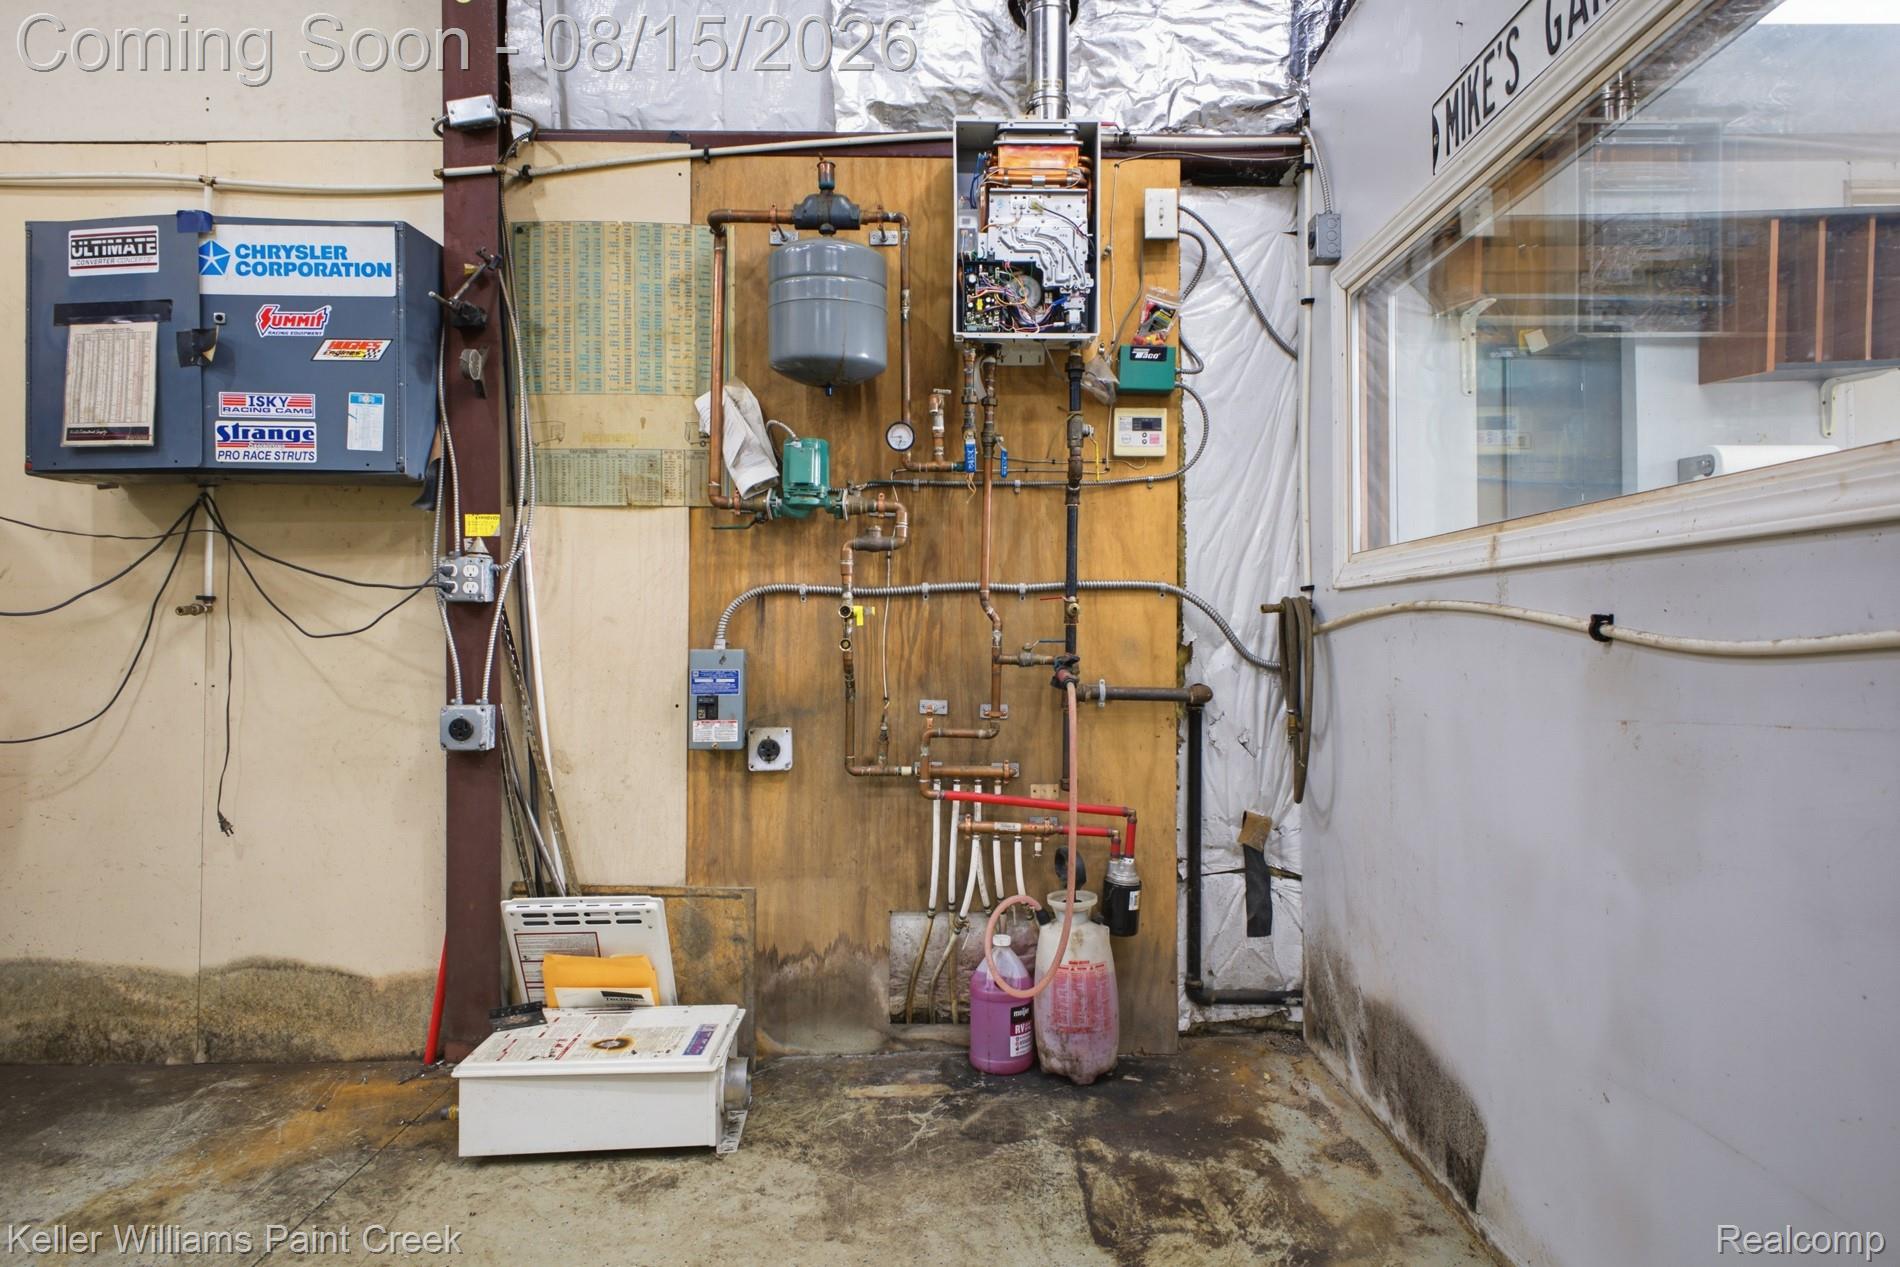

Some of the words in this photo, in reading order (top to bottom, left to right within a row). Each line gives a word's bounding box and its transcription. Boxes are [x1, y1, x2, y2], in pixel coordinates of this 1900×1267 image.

[1446, 26, 1519, 156] MIKE'S
[71, 237, 157, 258] ULTIMATE
[235, 243, 349, 260] CHRYSLER
[235, 260, 393, 278] CORPORATION
[248, 395, 289, 408] ISKY
[216, 422, 315, 443] Strange
[217, 450, 240, 460] PRO
[242, 450, 272, 460] RACE
[273, 451, 315, 461] STRUTS
